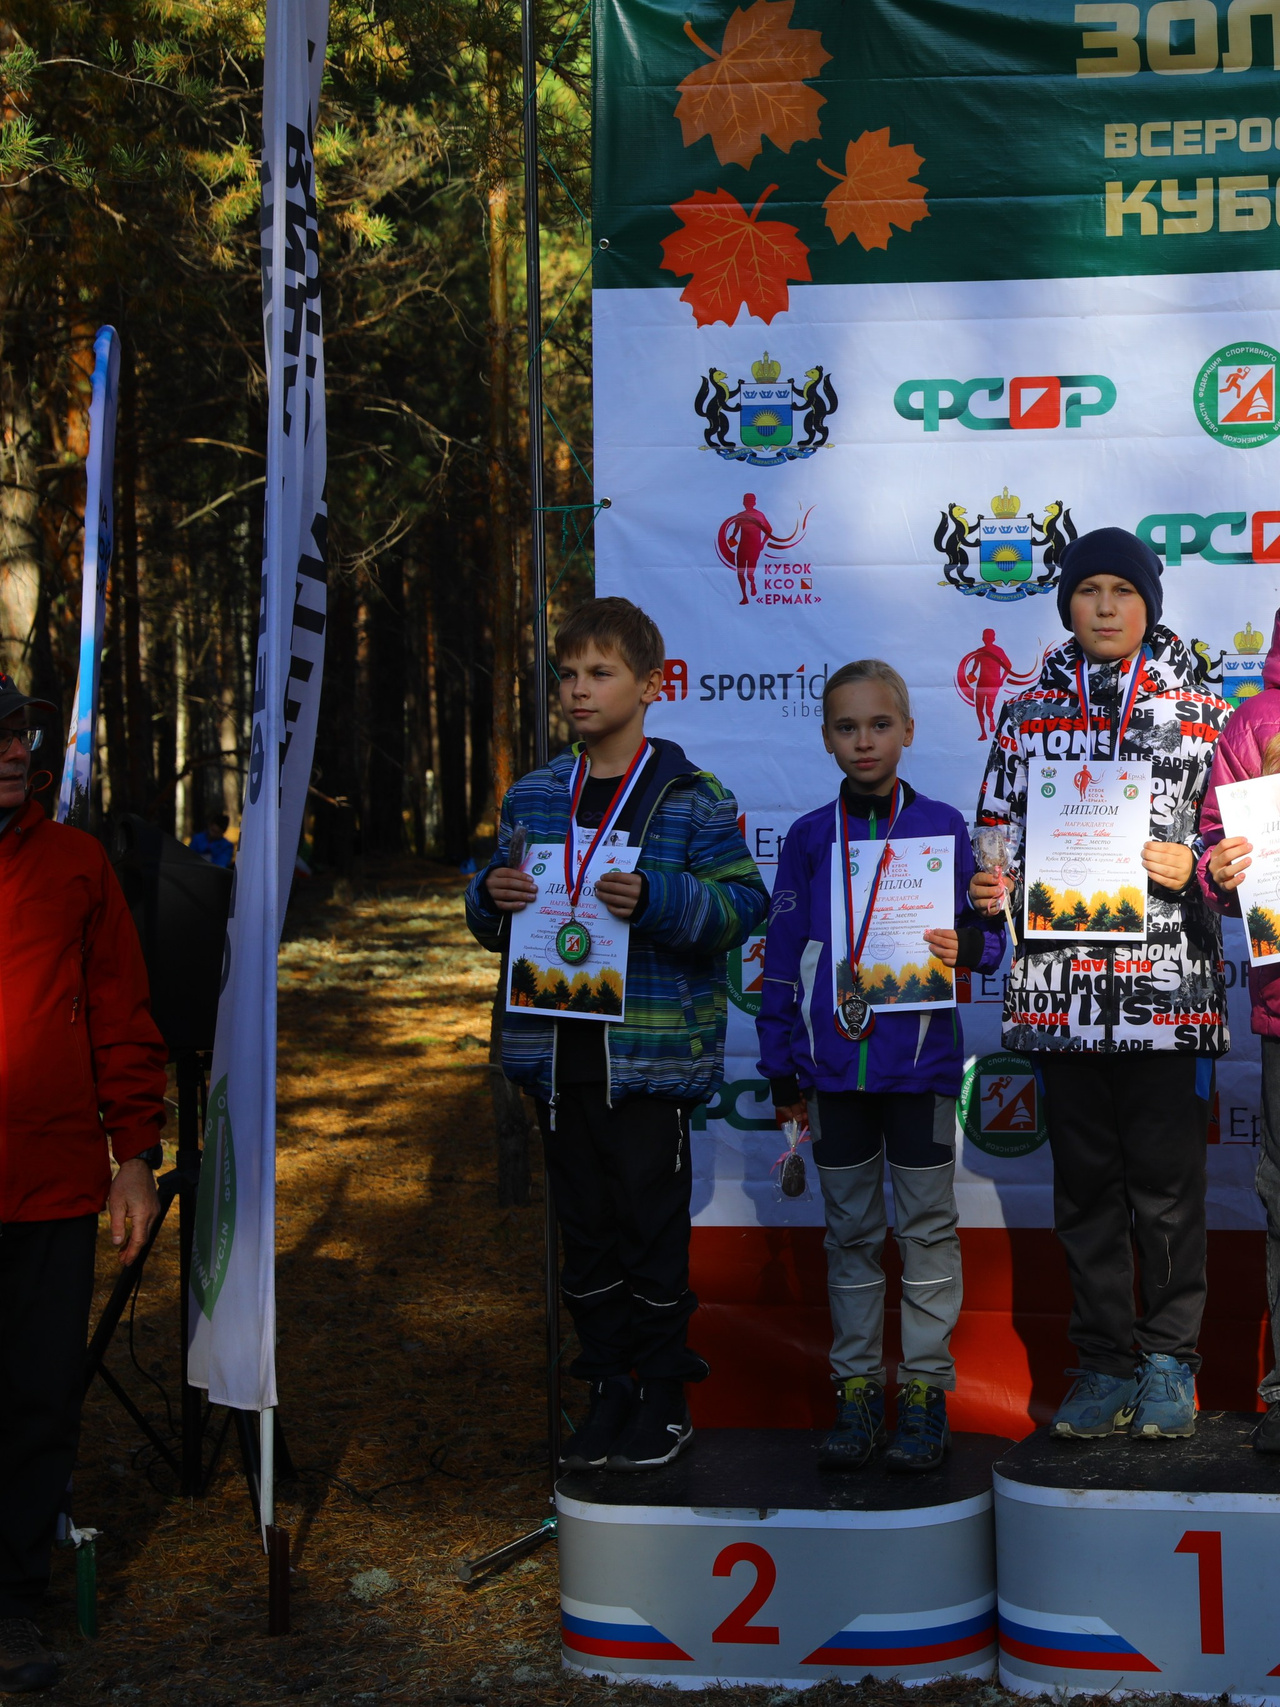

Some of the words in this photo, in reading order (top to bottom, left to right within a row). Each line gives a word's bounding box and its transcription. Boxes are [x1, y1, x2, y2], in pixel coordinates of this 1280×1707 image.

[1225, 346, 1278, 362] СПОРТИВНОГО
[1198, 357, 1222, 398] ФЕДЕРАЦИЯ
[1198, 402, 1219, 433] ОБЛАСТИ
[1223, 432, 1269, 444] ТЮМЕНСКОЙ
[764, 563, 812, 576] КУБОК
[764, 579, 795, 591] КСО
[756, 593, 822, 606] «ЕРМАК»
[700, 663, 829, 702] SPORTid
[782, 702, 822, 718] sibe
[1059, 804, 1119, 816] ДИПЛОМ
[1065, 821, 1115, 829] НАГРАЖДАЕТСЯ
[1115, 943, 1182, 961] SNOW
[711, 1542, 780, 1645] 2
[1174, 1530, 1226, 1655] 1
